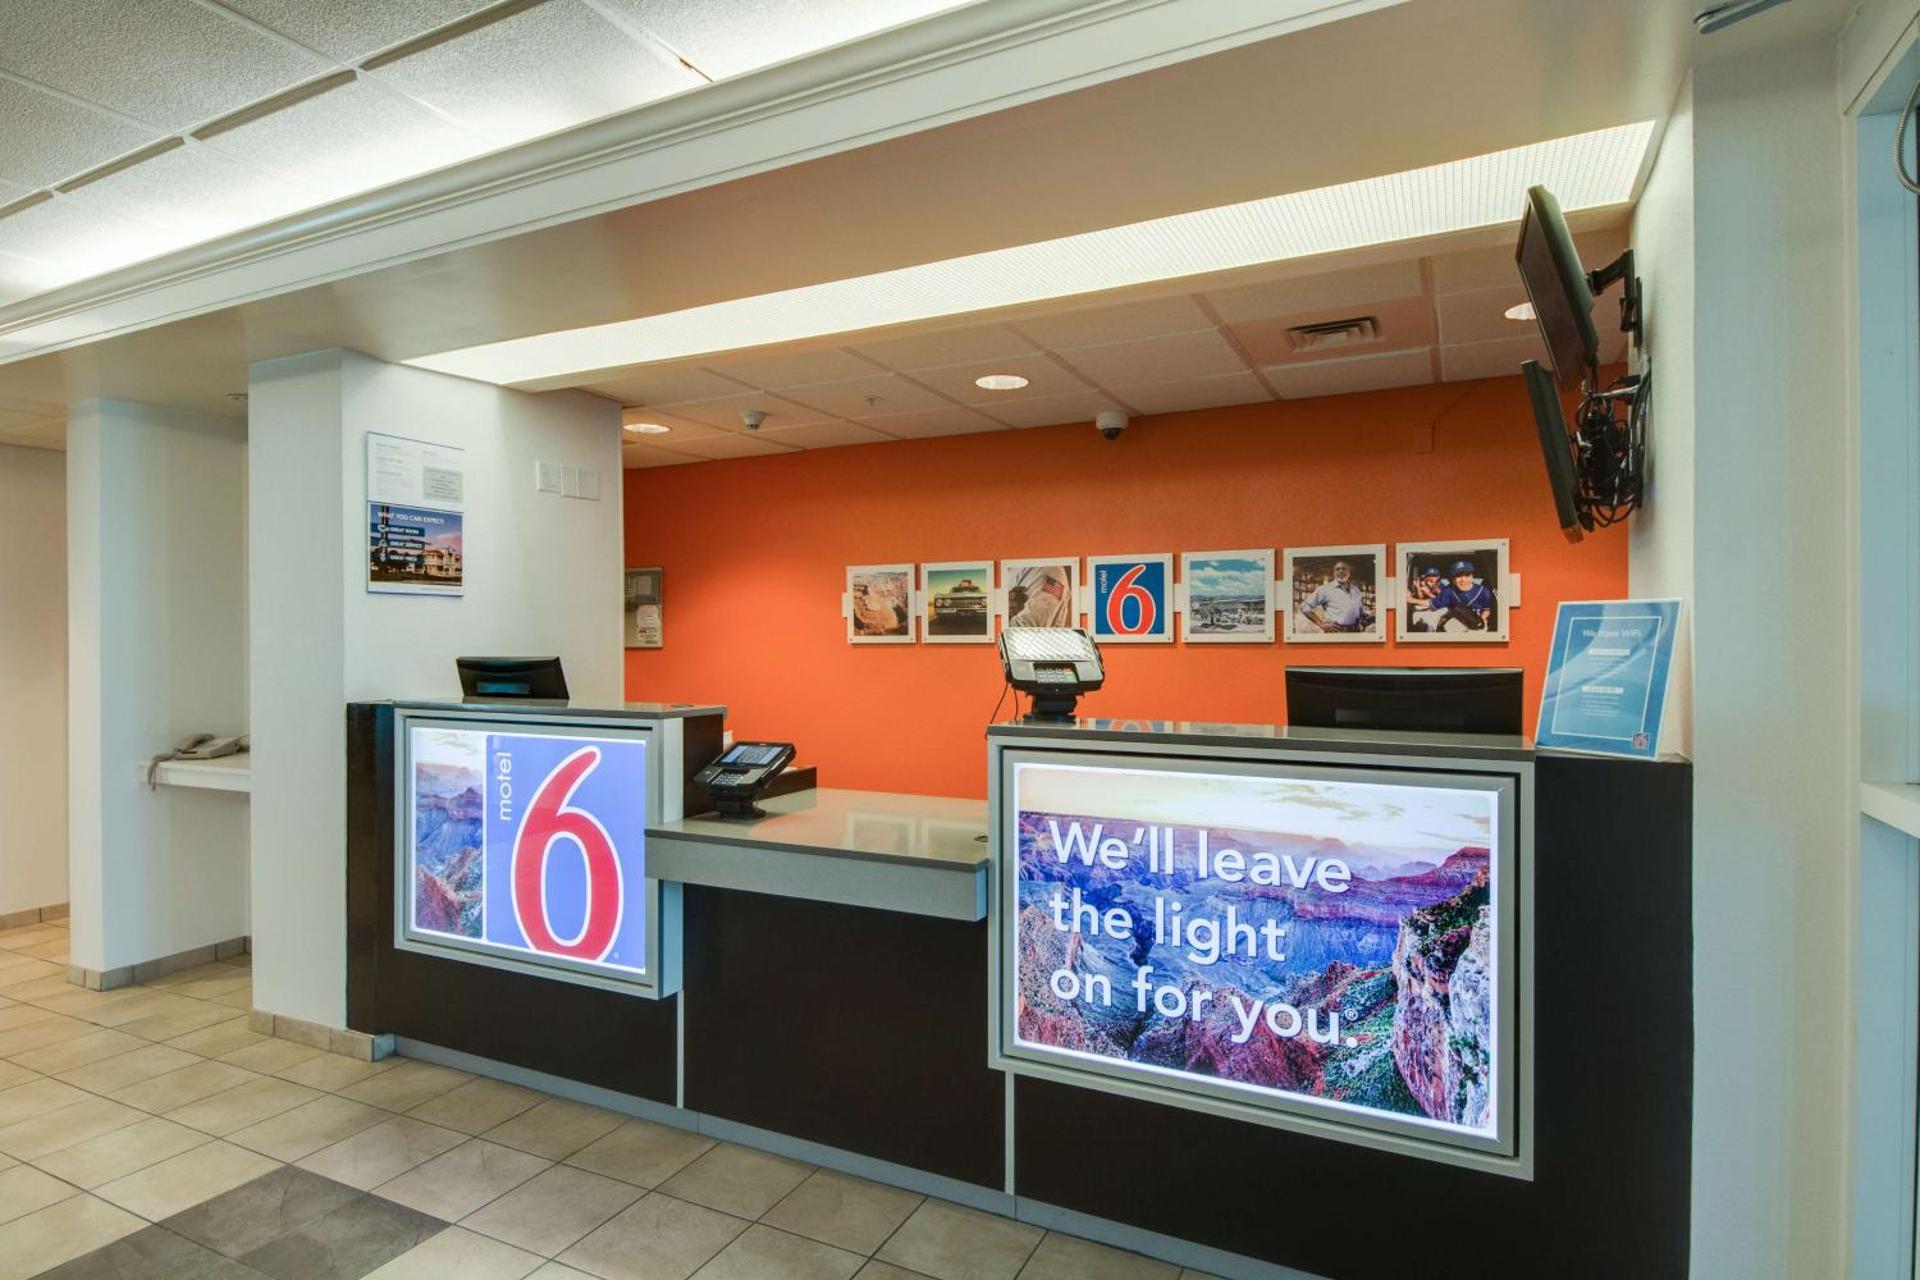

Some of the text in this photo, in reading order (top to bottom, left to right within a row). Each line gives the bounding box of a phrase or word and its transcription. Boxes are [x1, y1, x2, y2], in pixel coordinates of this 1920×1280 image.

[1099, 564, 1156, 635] motel 6
[496, 745, 624, 961] motel 6
[1048, 820, 1352, 894] We'll leave
[1048, 887, 1287, 966] the light
[1050, 968, 1113, 1007] on
[1131, 964, 1213, 1022] for
